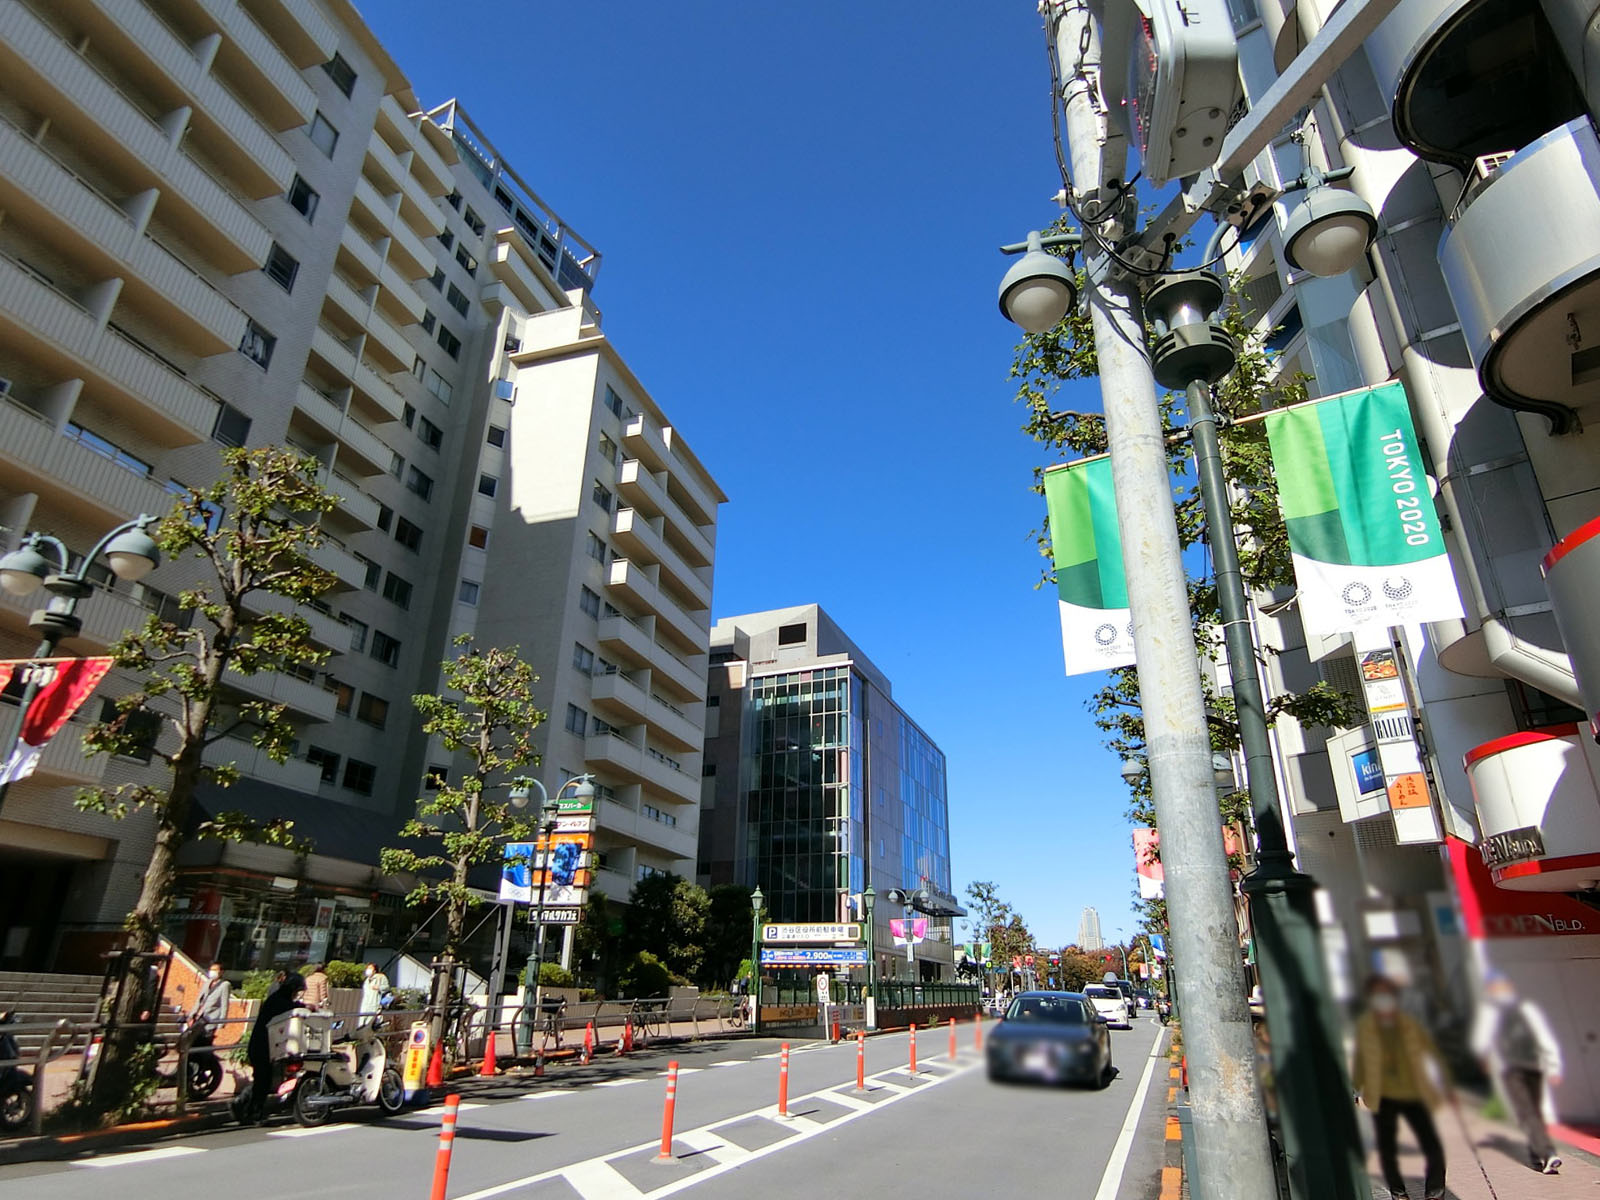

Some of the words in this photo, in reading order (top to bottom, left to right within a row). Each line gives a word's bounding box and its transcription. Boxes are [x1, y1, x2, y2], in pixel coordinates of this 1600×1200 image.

[1380, 429, 1415, 494] TOKYO
[1396, 496, 1429, 546] 2020
[1375, 717, 1411, 739] BALLET
[1361, 762, 1381, 776] kin
[1555, 919, 1587, 931] BLD.
